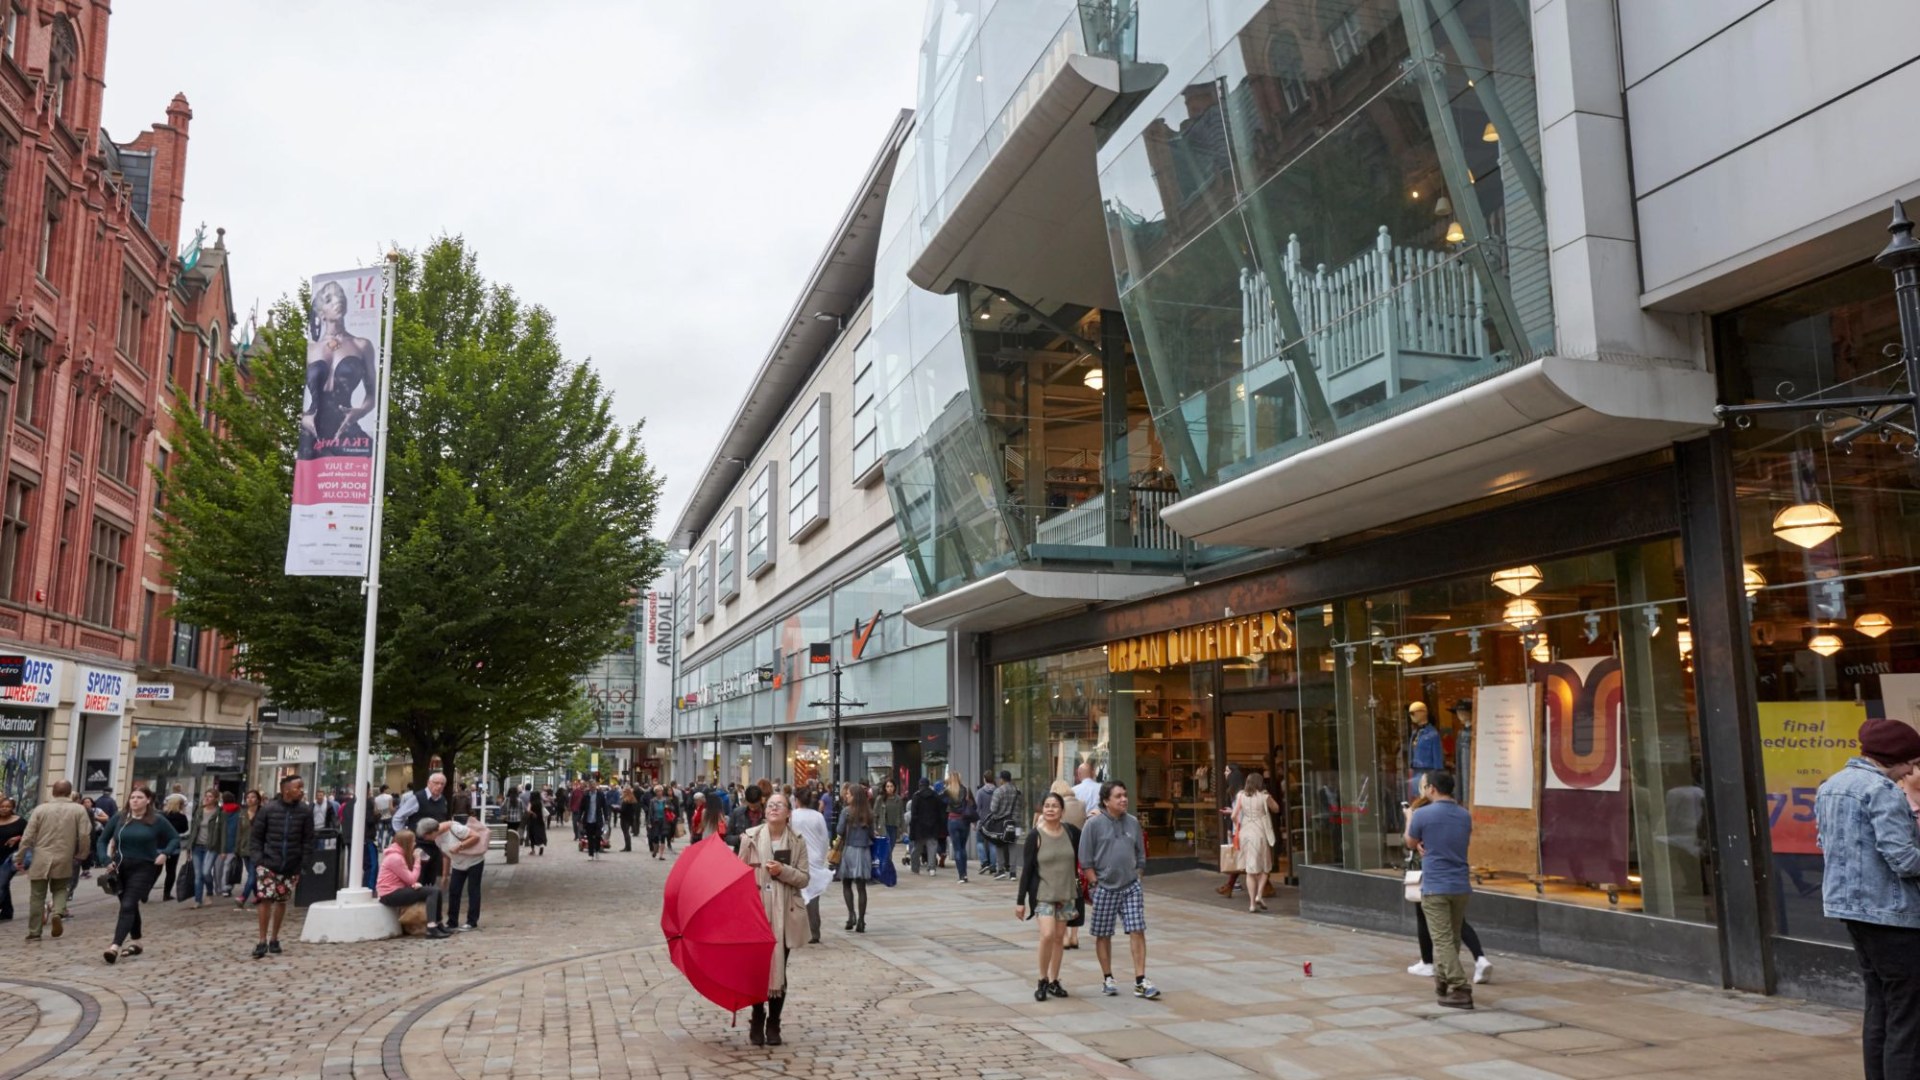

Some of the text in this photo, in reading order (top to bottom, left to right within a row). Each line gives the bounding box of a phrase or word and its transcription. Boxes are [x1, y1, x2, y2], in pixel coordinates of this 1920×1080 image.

[648, 592, 657, 644] MANCHESTER
[657, 591, 673, 667] ARNDALE
[1108, 608, 1293, 672] URBAN OUTFITTERS
[23, 658, 53, 685] ORTS
[87, 671, 122, 696] SPORTS
[0, 713, 37, 732] karrimor
[1783, 719, 1826, 733] final
[1760, 736, 1857, 748] eductions
[1767, 779, 1826, 828] 75
